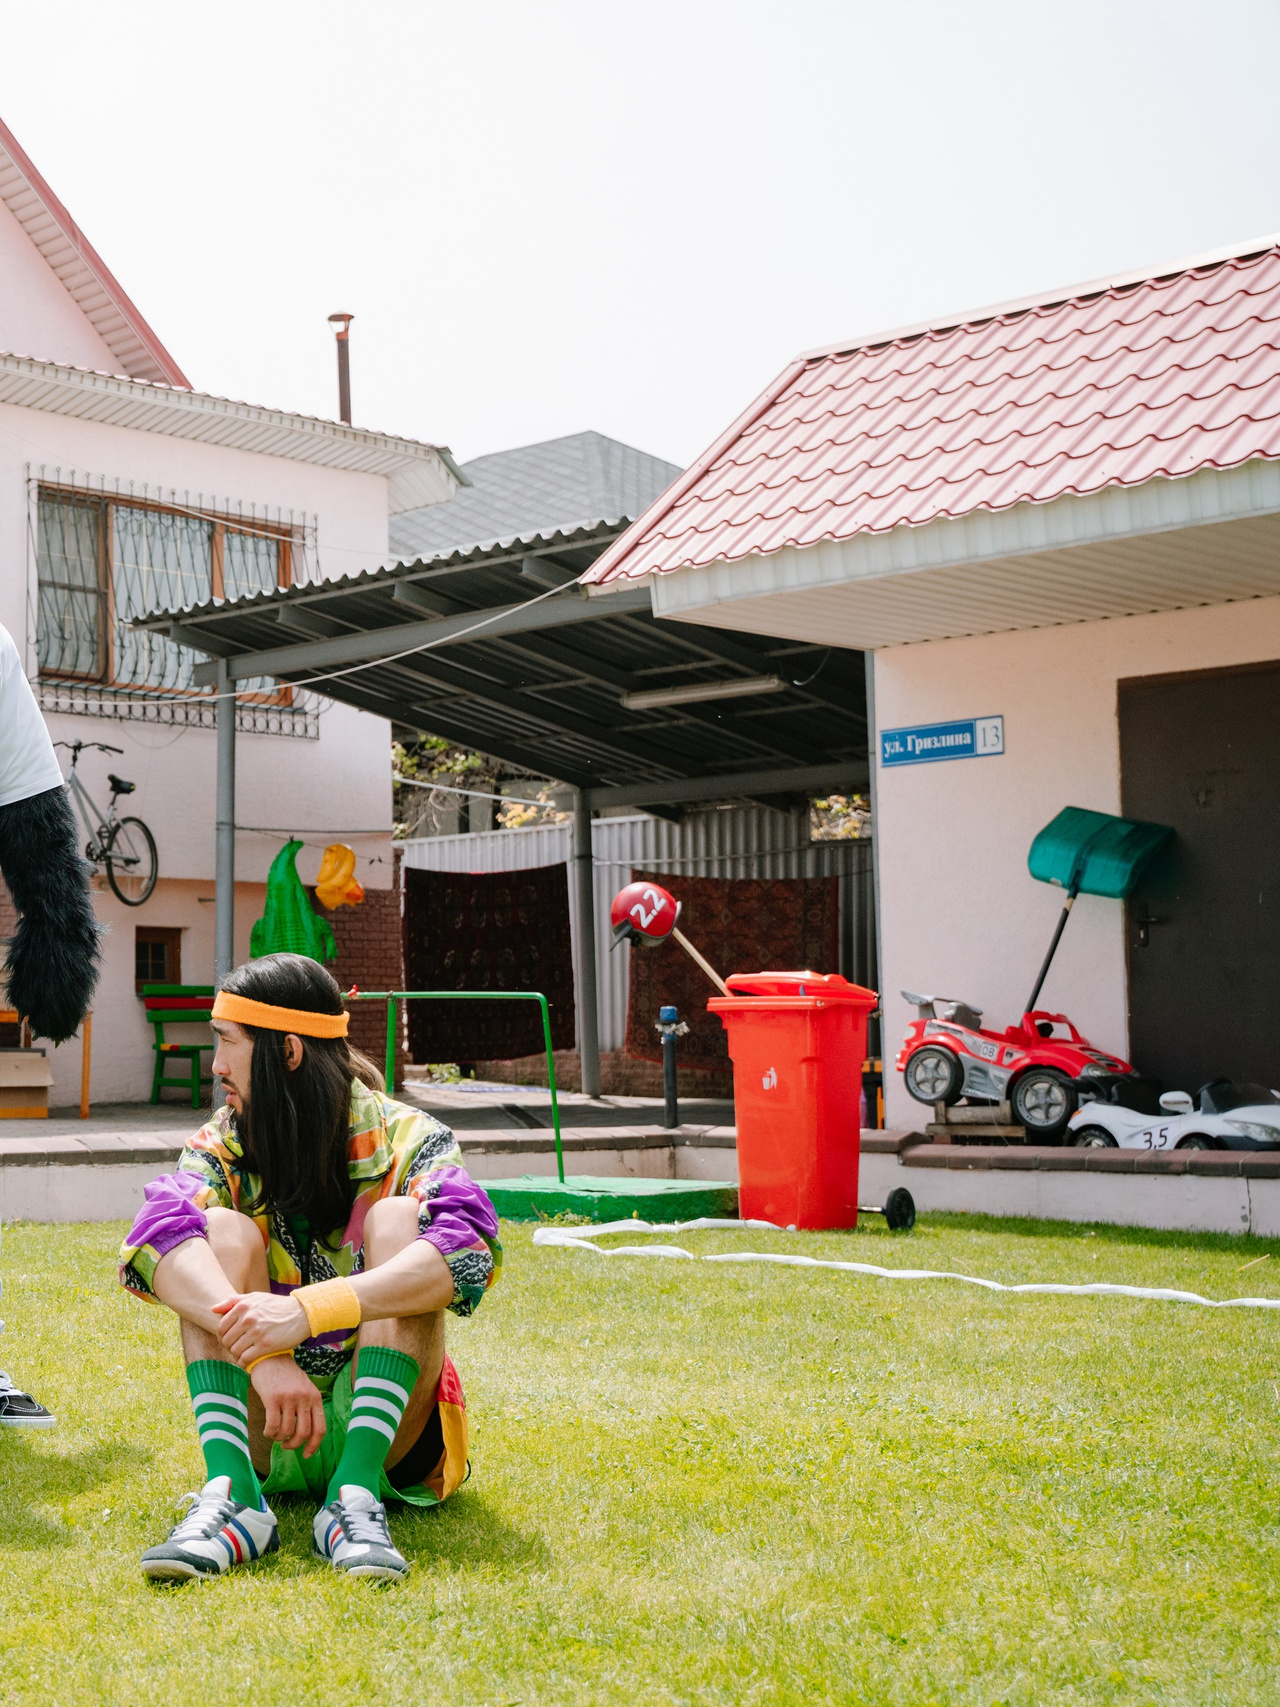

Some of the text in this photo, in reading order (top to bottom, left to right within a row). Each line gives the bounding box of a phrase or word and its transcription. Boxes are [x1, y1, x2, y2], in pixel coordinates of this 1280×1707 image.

[884, 725, 1000, 758] ул. Гризлина 13
